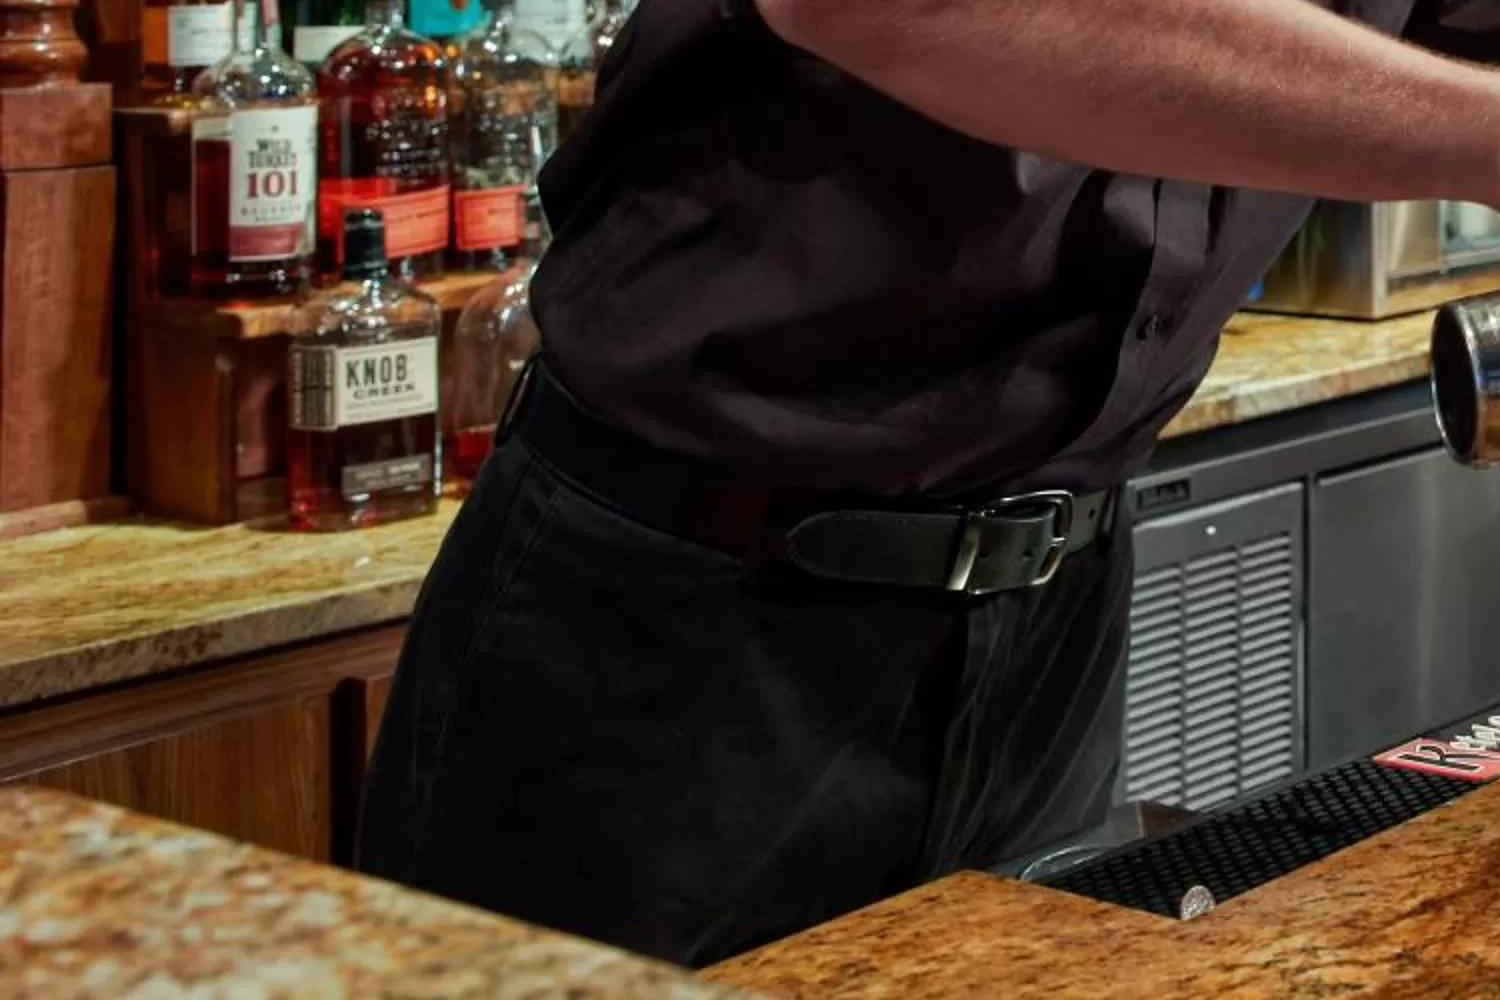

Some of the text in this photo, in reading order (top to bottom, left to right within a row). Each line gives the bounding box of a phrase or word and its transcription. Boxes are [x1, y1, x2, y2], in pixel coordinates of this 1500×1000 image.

[247, 170, 298, 199] 101
[346, 353, 408, 389] KNOB
[353, 383, 416, 401] CREEK
